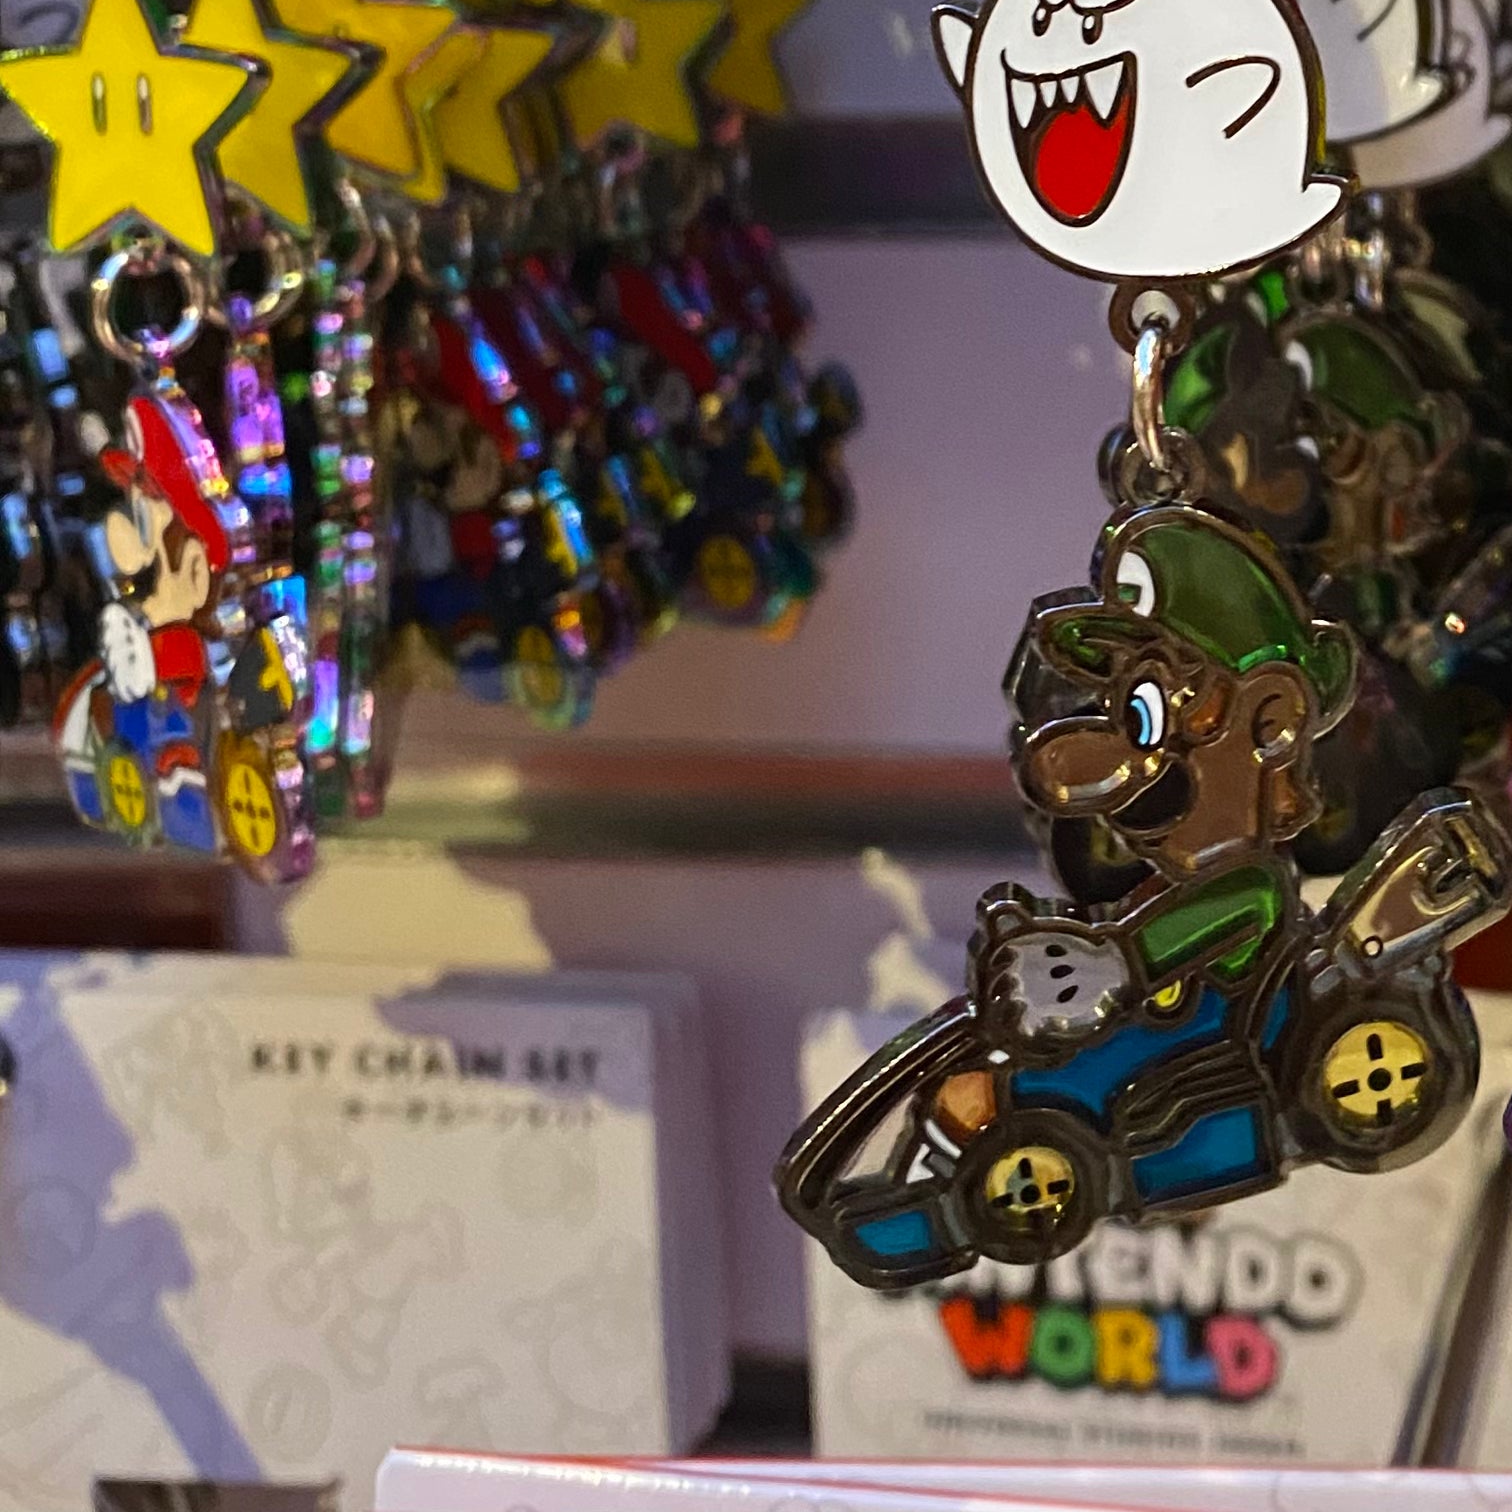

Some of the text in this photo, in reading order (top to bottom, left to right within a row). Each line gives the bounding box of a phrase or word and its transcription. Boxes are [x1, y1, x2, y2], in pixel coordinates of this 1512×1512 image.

[252, 1043, 598, 1083] KEY CHAIN SET
[937, 1290, 1280, 1405] WORLD
